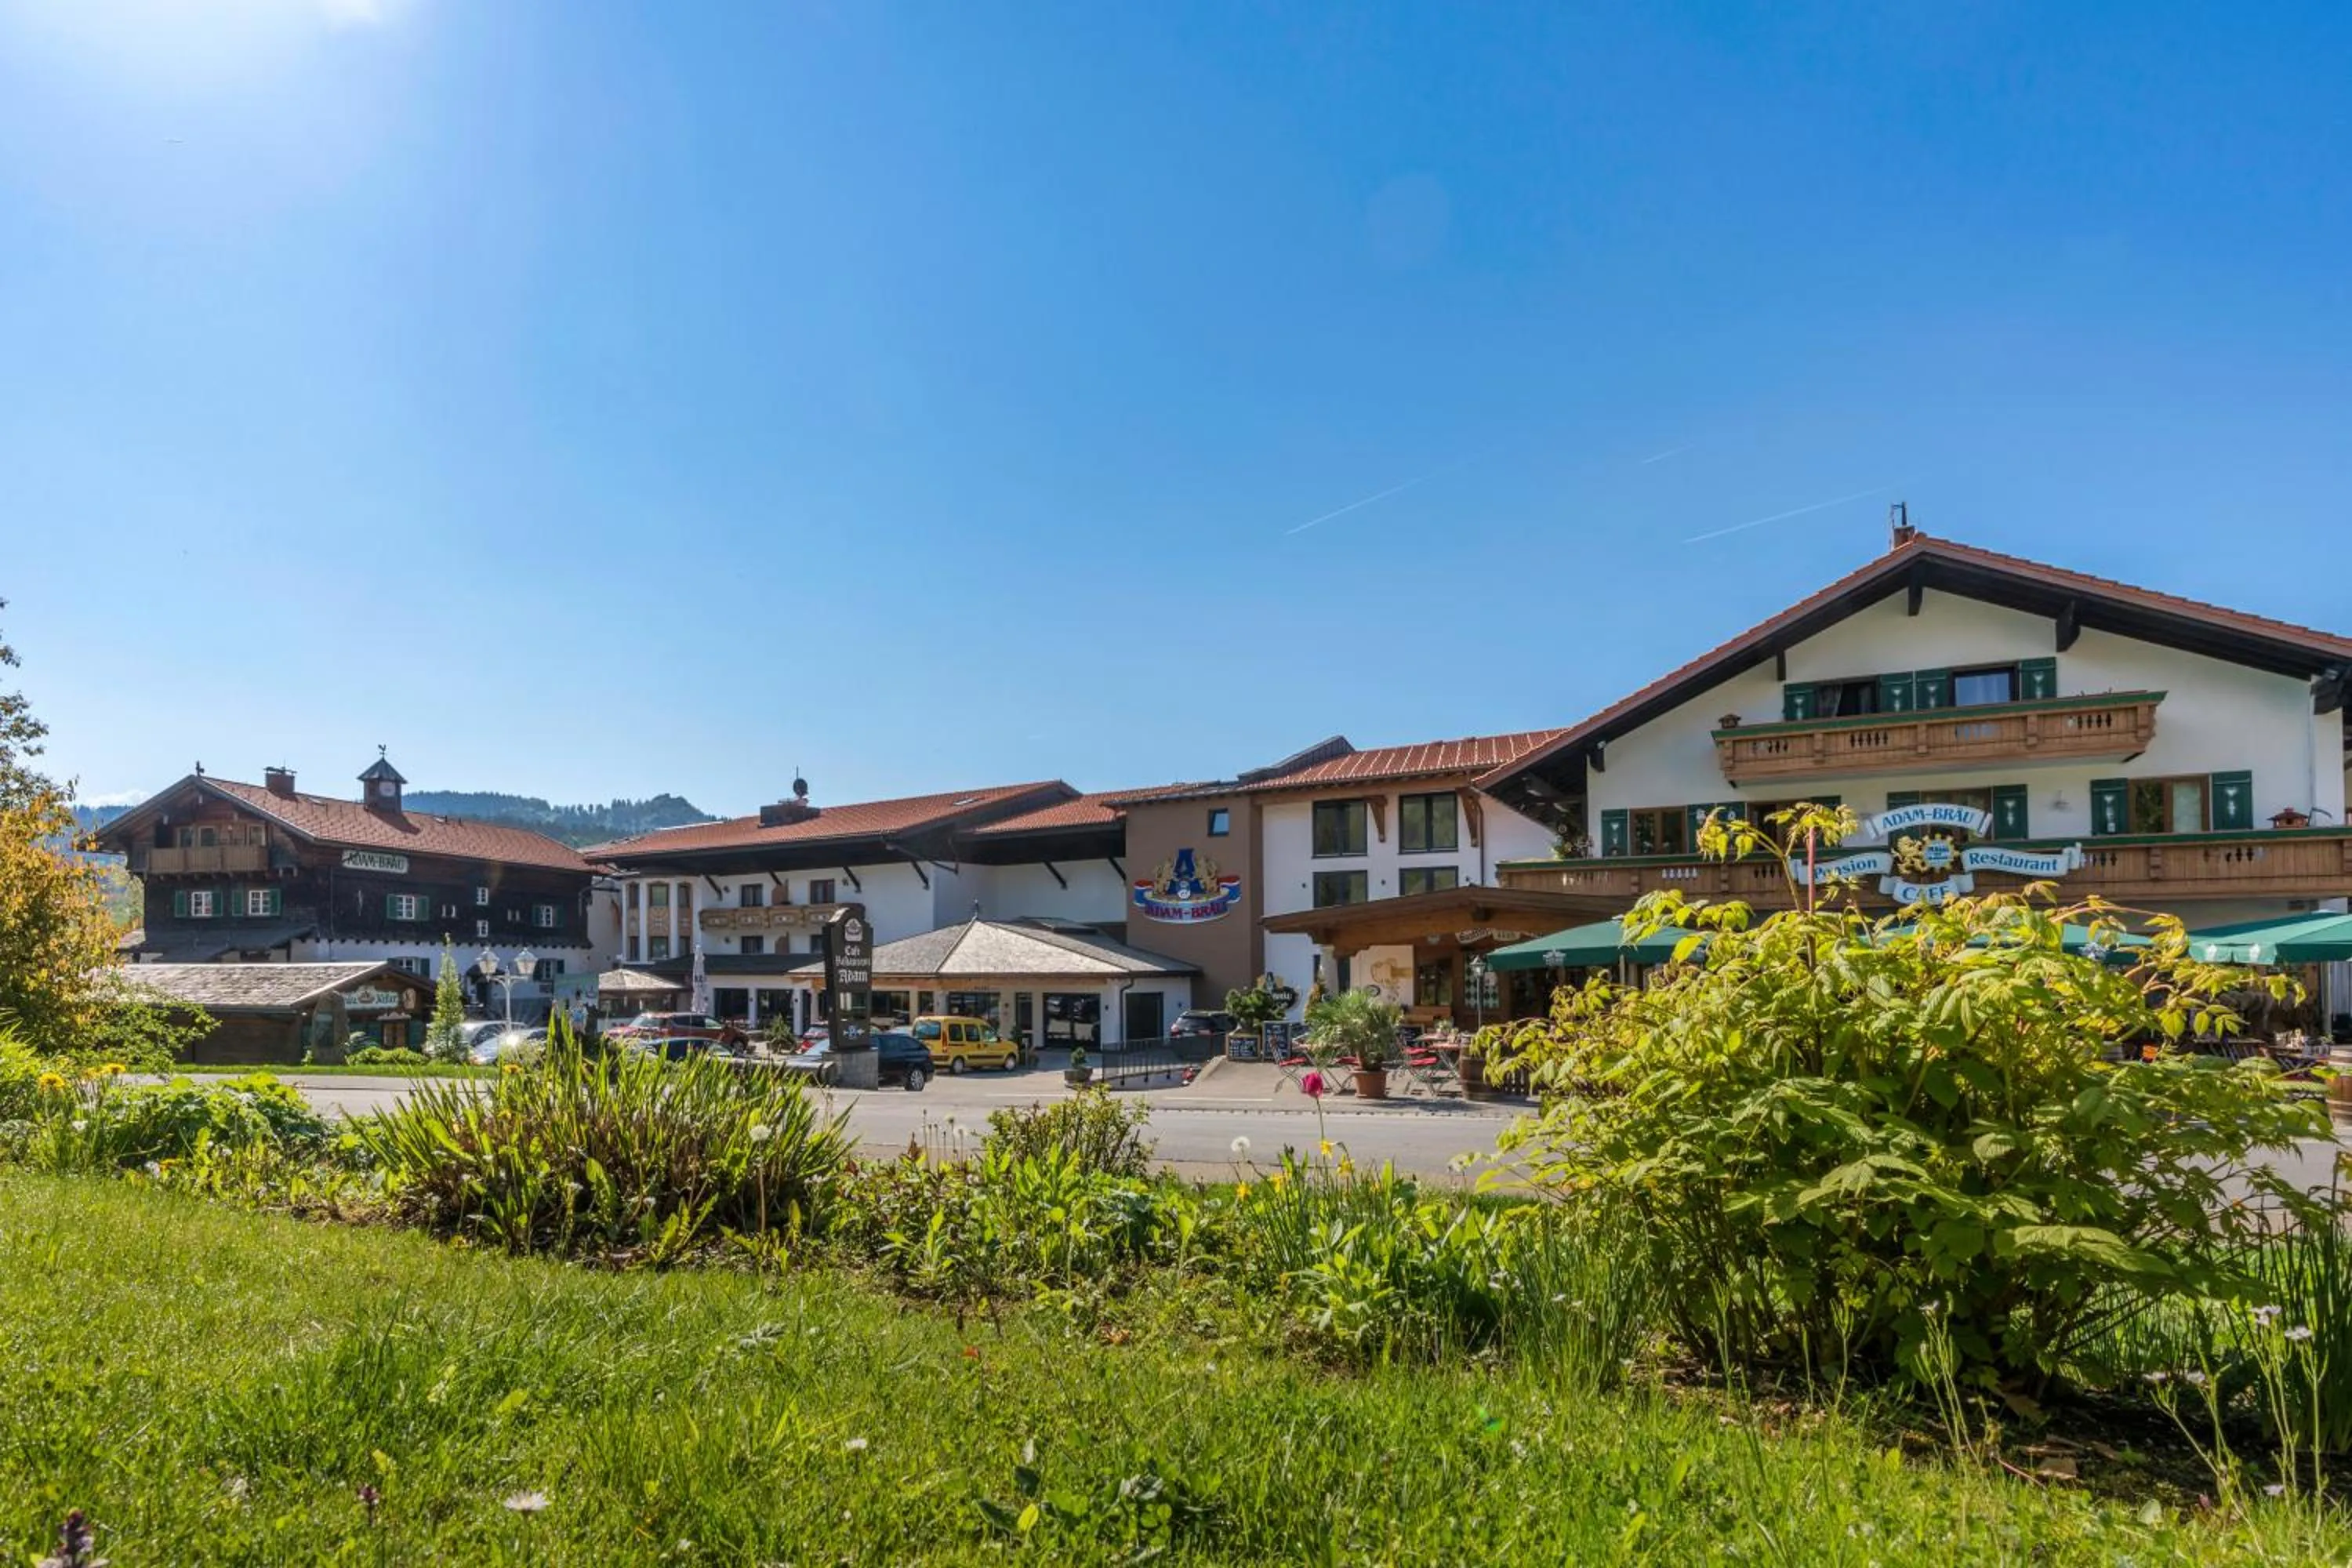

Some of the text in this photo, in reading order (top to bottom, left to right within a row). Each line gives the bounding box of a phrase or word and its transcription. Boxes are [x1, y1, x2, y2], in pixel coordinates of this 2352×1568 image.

[1882, 805, 1973, 829] ADAM-BRÄU
[1969, 852, 2058, 871] Restaurant
[838, 969, 868, 984] Adam
